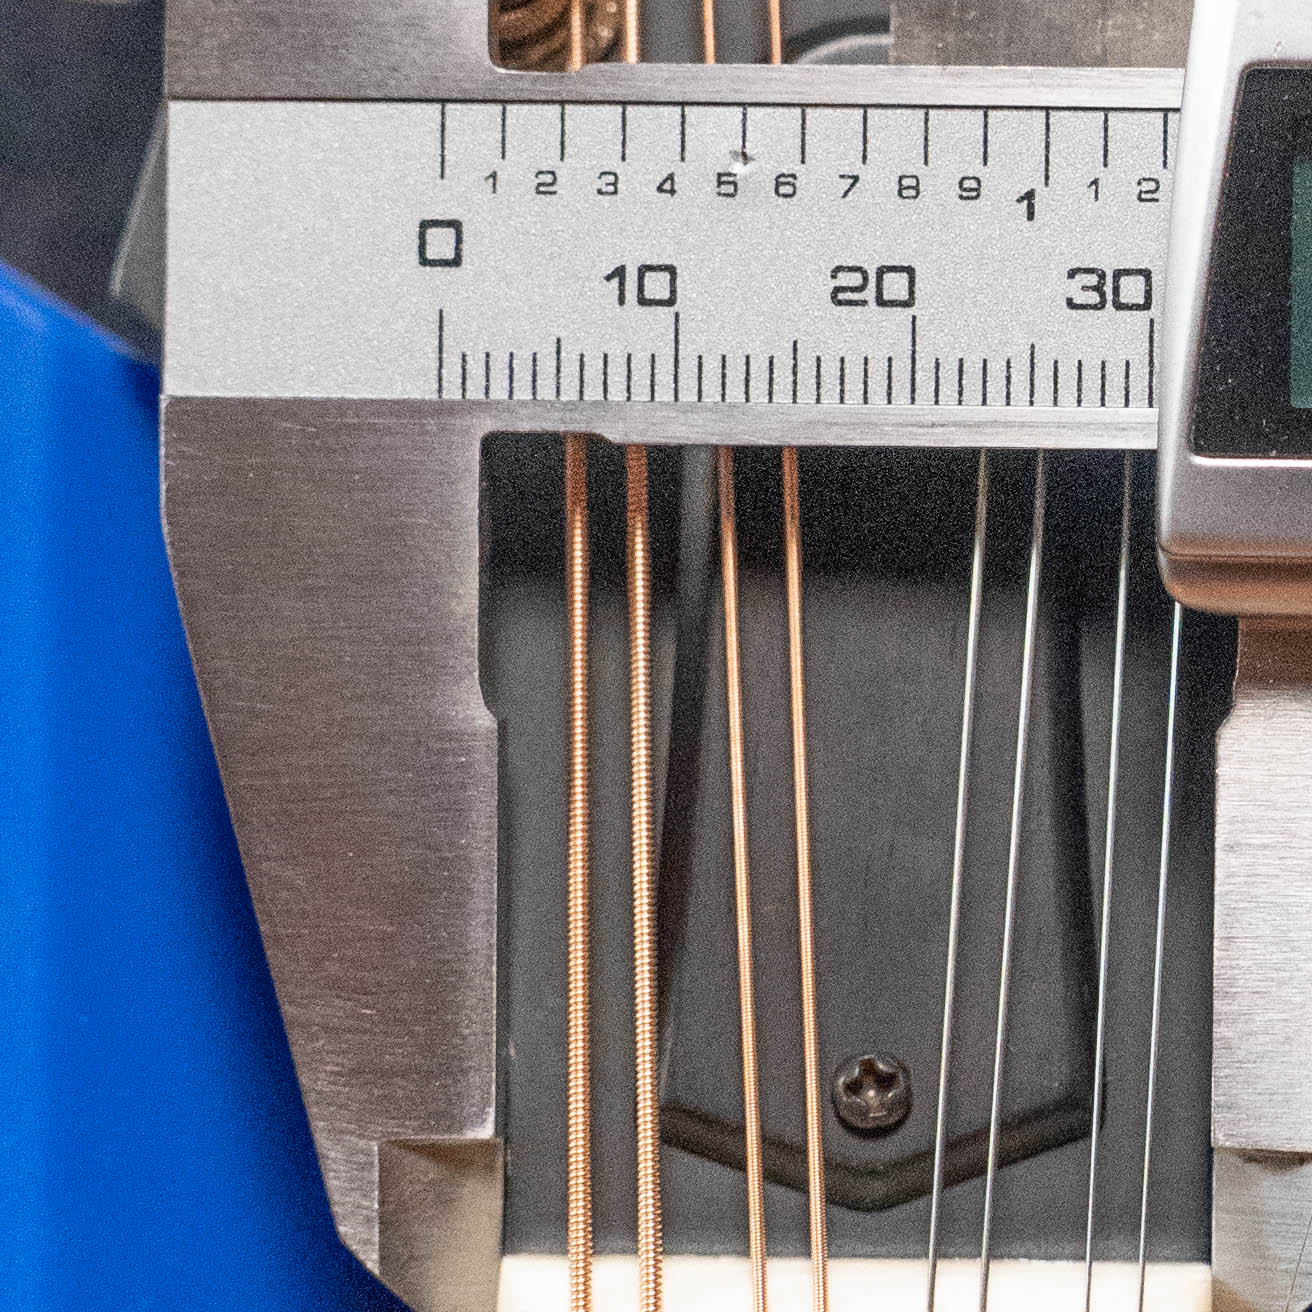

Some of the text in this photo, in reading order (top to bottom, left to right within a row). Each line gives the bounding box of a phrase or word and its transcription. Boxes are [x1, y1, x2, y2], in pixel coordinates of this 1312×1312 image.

[485, 171, 1159, 221] 1 2 3 4 5 6 7 8 9 1 1 2
[418, 220, 1152, 311] 0 10 20 30
